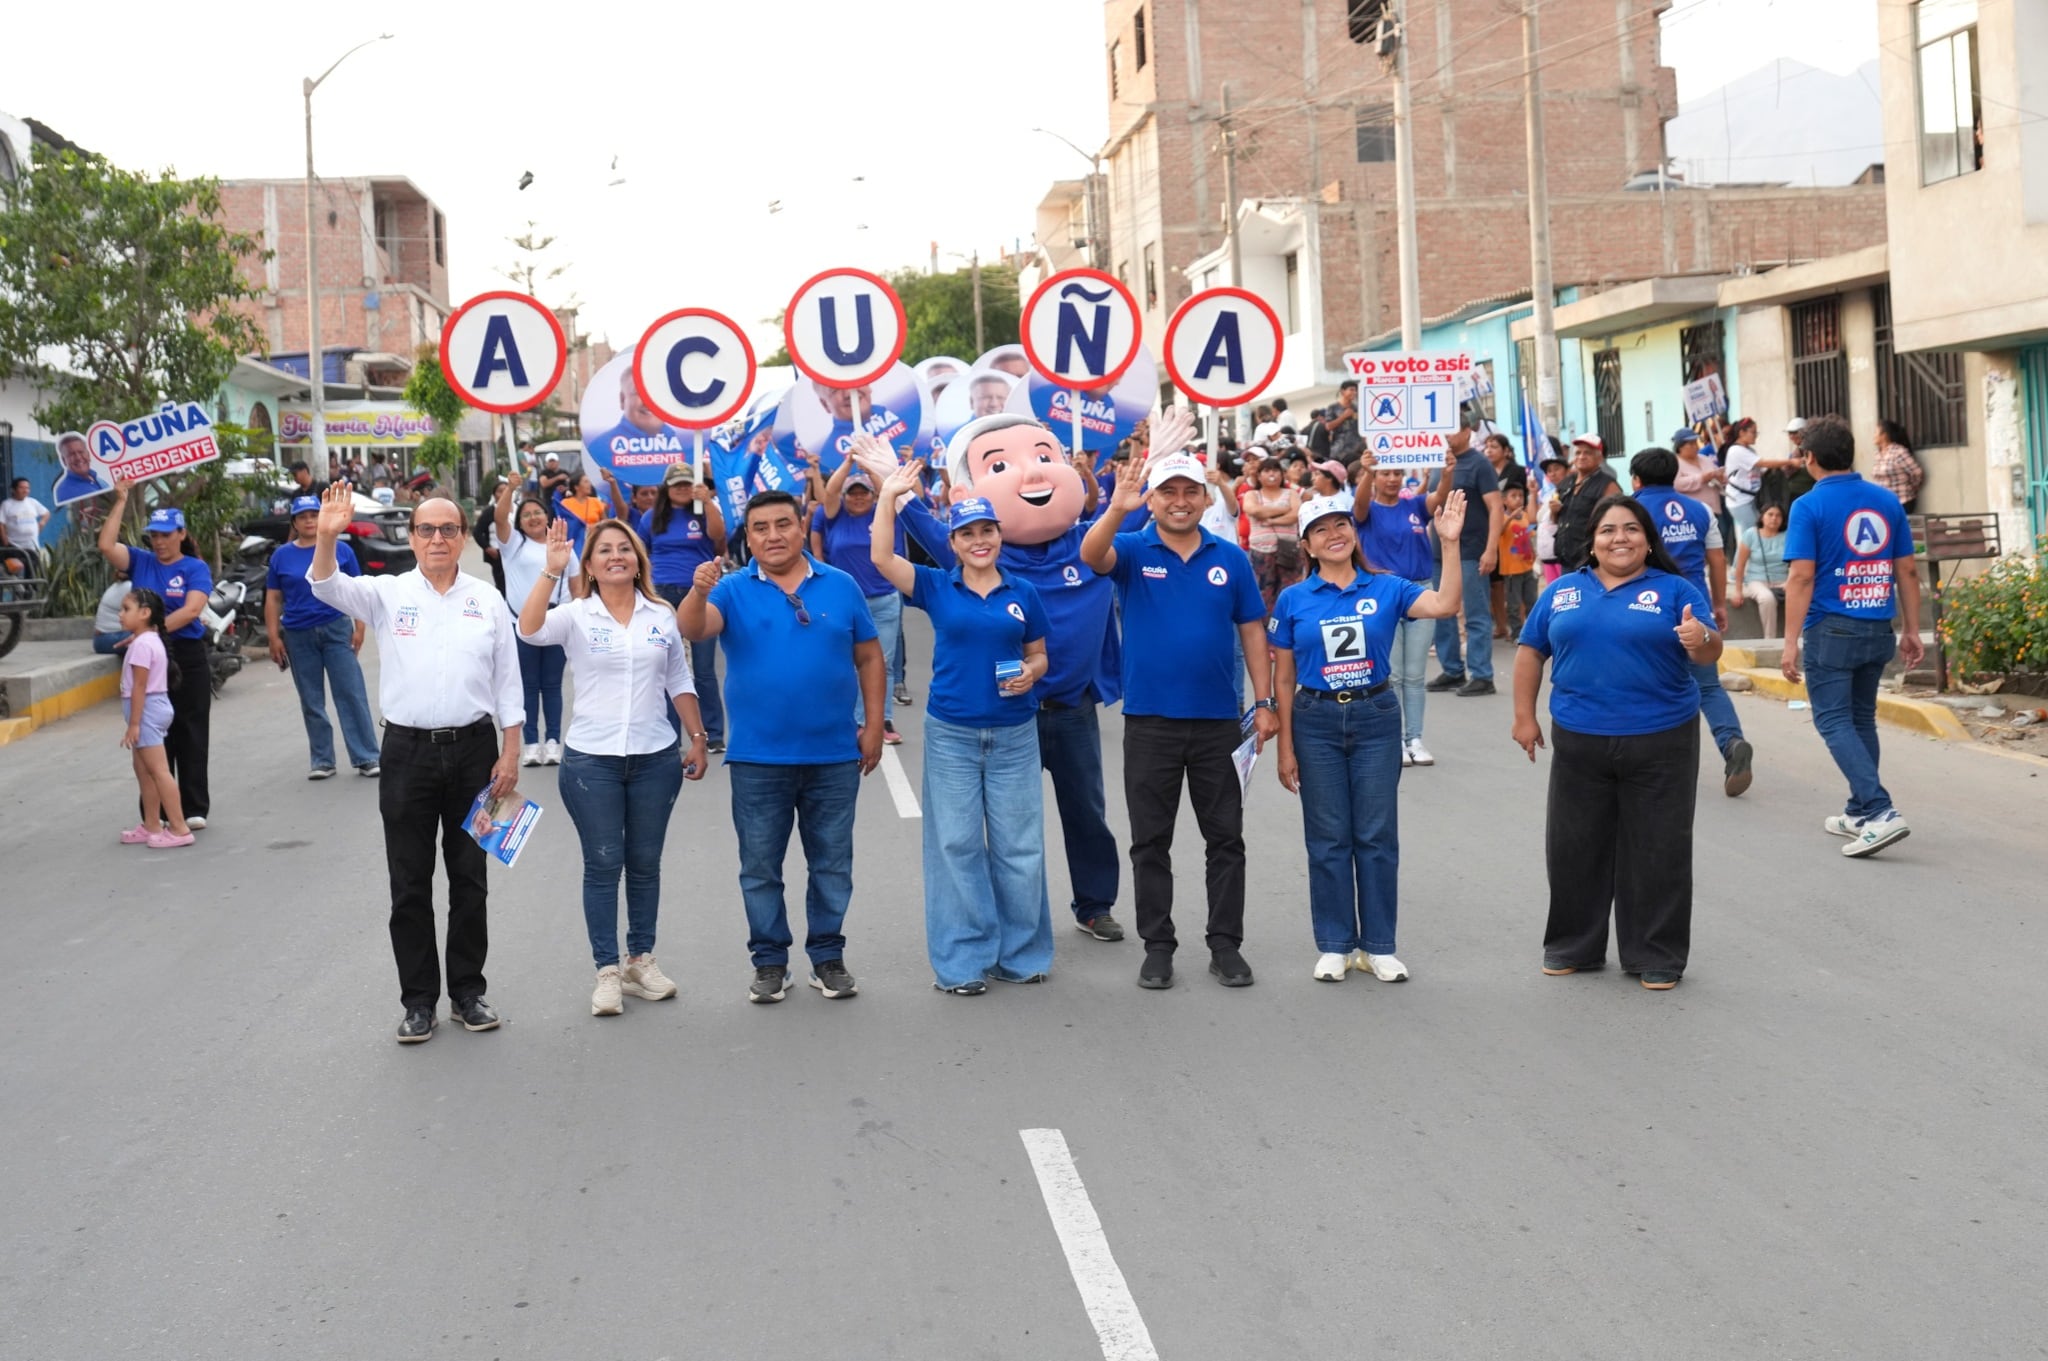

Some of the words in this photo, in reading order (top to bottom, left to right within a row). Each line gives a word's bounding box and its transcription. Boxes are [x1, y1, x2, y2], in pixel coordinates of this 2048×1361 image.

[818, 294, 875, 366] U
[1054, 283, 1113, 376] Ñ
[472, 314, 530, 388] A
[1193, 310, 1246, 385] A
[665, 336, 726, 408] C
[1349, 358, 1376, 374] Yo
[1381, 357, 1429, 373] voto
[1434, 353, 1470, 371] así:
[1055, 393, 1116, 422] AUÑA
[1424, 391, 1437, 423] 1
[98, 404, 210, 457] ACUÑA
[1049, 407, 1114, 434] PREDENTE
[612, 434, 683, 453] ACUÑA
[1377, 431, 1442, 449] ACUÑA
[111, 440, 214, 484] PRESIDENTE
[614, 454, 681, 466] PRESIDENTE
[1375, 453, 1443, 464] PRESIDENTE
[1671, 504, 1681, 517] A
[1662, 521, 1697, 538] ACUÑA
[1855, 517, 1880, 545] A
[1142, 566, 1167, 574] ACUÑA
[1213, 570, 1224, 581] A
[1848, 577, 1861, 585] LO
[1863, 576, 1889, 585] DICE
[1361, 602, 1373, 611] A
[1642, 594, 1653, 602] A
[1331, 626, 1360, 658] 2
[1325, 661, 1369, 674] DIPUTADA
[1329, 677, 1371, 690] ESOBAL
